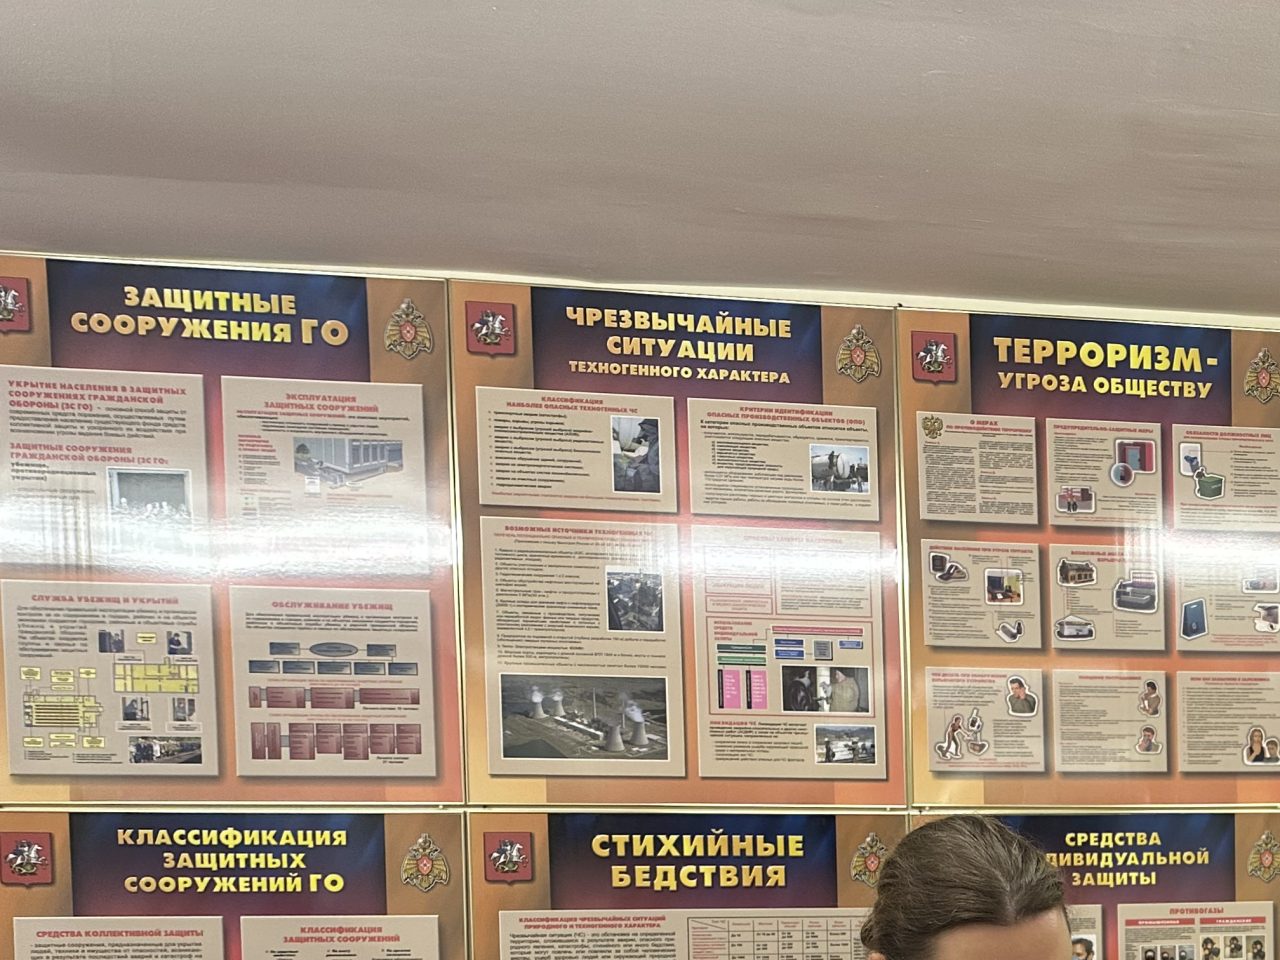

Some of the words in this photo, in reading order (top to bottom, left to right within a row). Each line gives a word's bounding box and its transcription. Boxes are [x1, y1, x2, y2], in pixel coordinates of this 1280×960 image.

[123, 285, 296, 315] ЗАЩИТНЫЕ
[70, 312, 291, 343] СООРУЖЕНИЯ
[301, 319, 349, 346] ГО
[566, 306, 791, 338] ЧРЕЗВЫЧАЙНЫЕ
[606, 338, 754, 363] СИТУАЦИИ
[569, 360, 693, 379] ТЕХНОГЕННОГО
[696, 367, 790, 385] ХАРАКТЕРА
[9, 380, 57, 389] УКРЫТИЕ
[60, 382, 118, 392] НАСЕЛЕНИЯ
[129, 386, 187, 395] ЗАЩИТНЫХ
[998, 372, 1087, 393] УГРОЗА
[1093, 379, 1214, 399] ОБЩЕСТВУ
[9, 400, 59, 409] ОБОРОНЫ
[77, 402, 93, 411] ГО)
[88, 394, 164, 404] ГРАЖДАНСКОЙ
[286, 393, 356, 402] ЭКСПЛУАТАЦИЯ
[264, 402, 315, 411] ЗАЩИТНЫХ
[317, 403, 379, 413] СООРУЖЕНИЙ
[10, 443, 63, 452] ЗАЩИТНЫЕ
[66, 444, 132, 453] СООРУЖЕНИЯ
[10, 452, 85, 462] ГРАЖДАНСКОЙ
[87, 454, 135, 463] ОБОРОНЫ
[117, 827, 347, 849] КЛАССИФИКАЦИЯ
[591, 829, 805, 858] СТИХИЙНЫЕ
[1065, 832, 1161, 847] СРЕДСТВА
[163, 852, 306, 872] ЗАЩИТНЫХ
[124, 872, 302, 893] СООРУЖЕНИЙ
[309, 874, 345, 893] ГО
[611, 865, 786, 892] БЕДСТВИЯ
[1072, 872, 1157, 888] ЗАЩИТЫ
[37, 931, 83, 939] СРЕДСТВА
[85, 929, 162, 937] КОЛЛЕКТИВНОЙ
[164, 930, 203, 938] ЗАЩИТЫ
[283, 936, 335, 944] ЗАЩИТНЫХ
[337, 935, 400, 943] СООРУЖЕНИЙ
